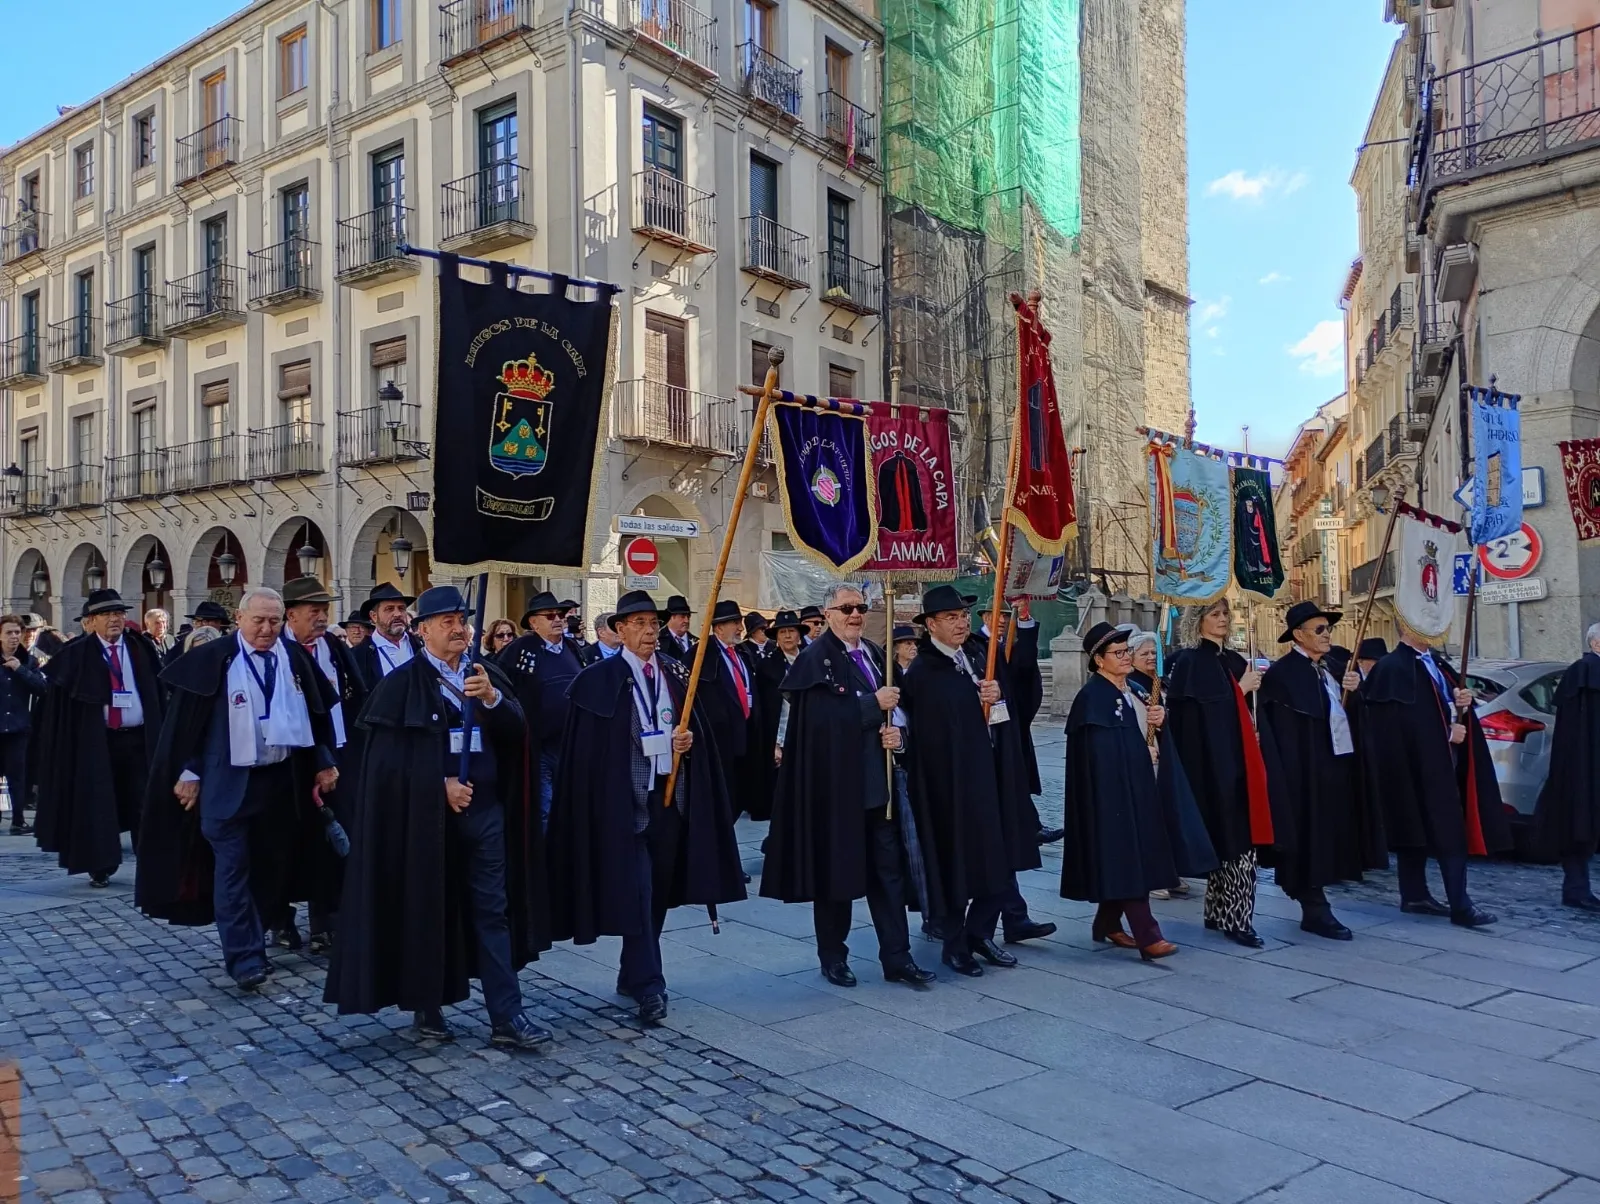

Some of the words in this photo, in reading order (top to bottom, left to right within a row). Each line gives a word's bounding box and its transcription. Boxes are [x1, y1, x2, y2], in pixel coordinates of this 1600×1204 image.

[465, 319, 512, 368] AMIGOS
[514, 317, 539, 329] DE
[541, 322, 559, 340] LA
[562, 339, 587, 378] CAPA
[904, 432, 922, 454] DE
[919, 446, 938, 470] LA
[933, 470, 949, 511] CAPA
[620, 520, 642, 530] todas
[644, 521, 655, 531] las
[657, 523, 684, 533] salidas
[873, 541, 946, 563] LAMANCA
[1496, 540, 1510, 559] 2
[1330, 560, 1338, 604] MIGUEL
